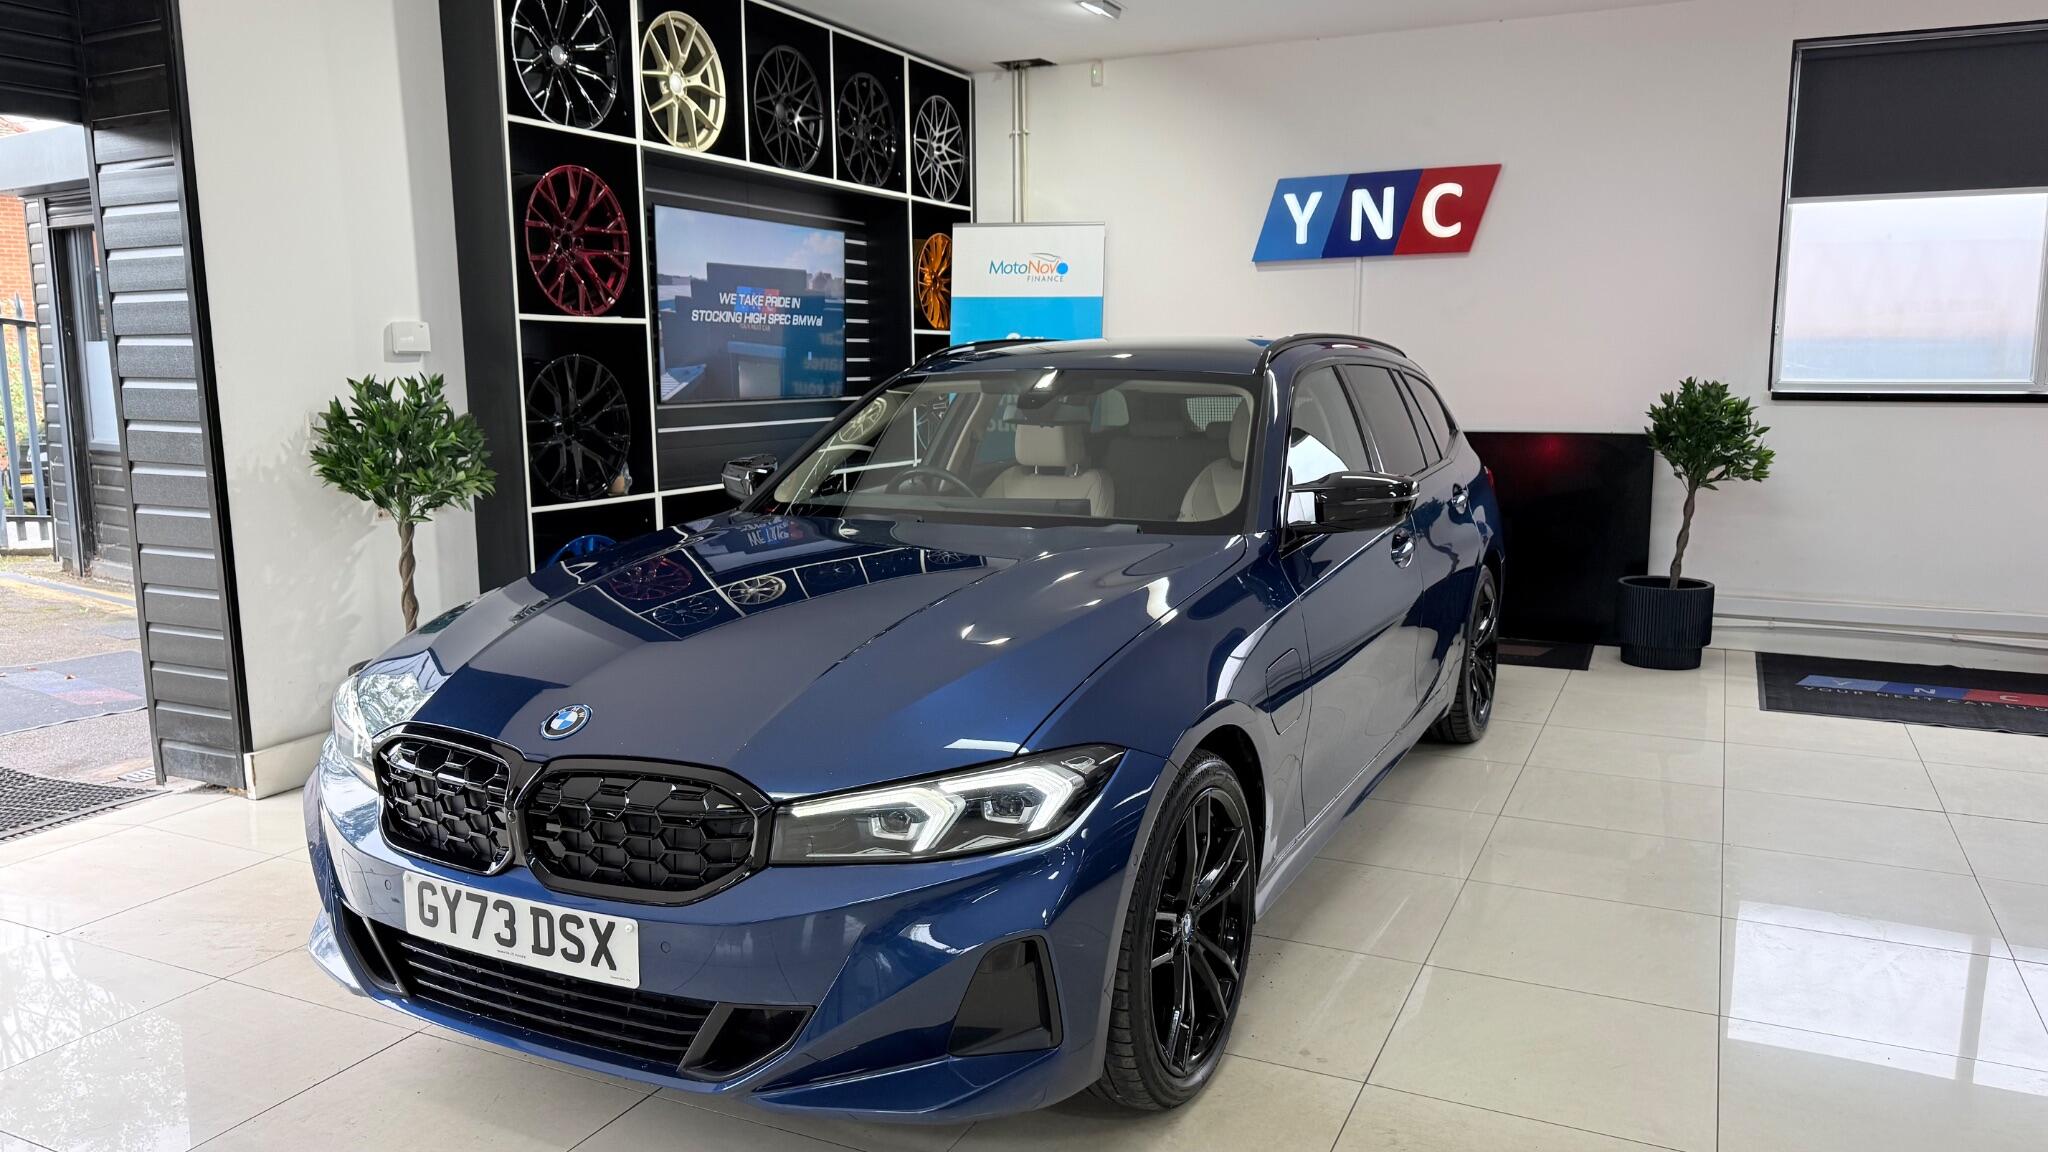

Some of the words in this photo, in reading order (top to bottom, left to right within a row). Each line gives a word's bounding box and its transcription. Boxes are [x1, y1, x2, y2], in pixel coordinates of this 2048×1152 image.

[1283, 182, 1463, 245] YNC
[1027, 275, 1064, 283] FINANCE
[719, 292, 737, 305] WE
[738, 293, 763, 307] TAKE
[764, 295, 791, 309] PRIDE
[791, 297, 801, 309] IN
[691, 309, 742, 323] STOCKING
[743, 311, 767, 325] HIGH
[768, 313, 791, 326] SPEC
[1804, 686, 1864, 696] YOUR
[1876, 692, 1936, 702] NEXT
[1946, 698, 1993, 707] CAR
[417, 880, 517, 948] GY73
[529, 905, 617, 971] DSX
